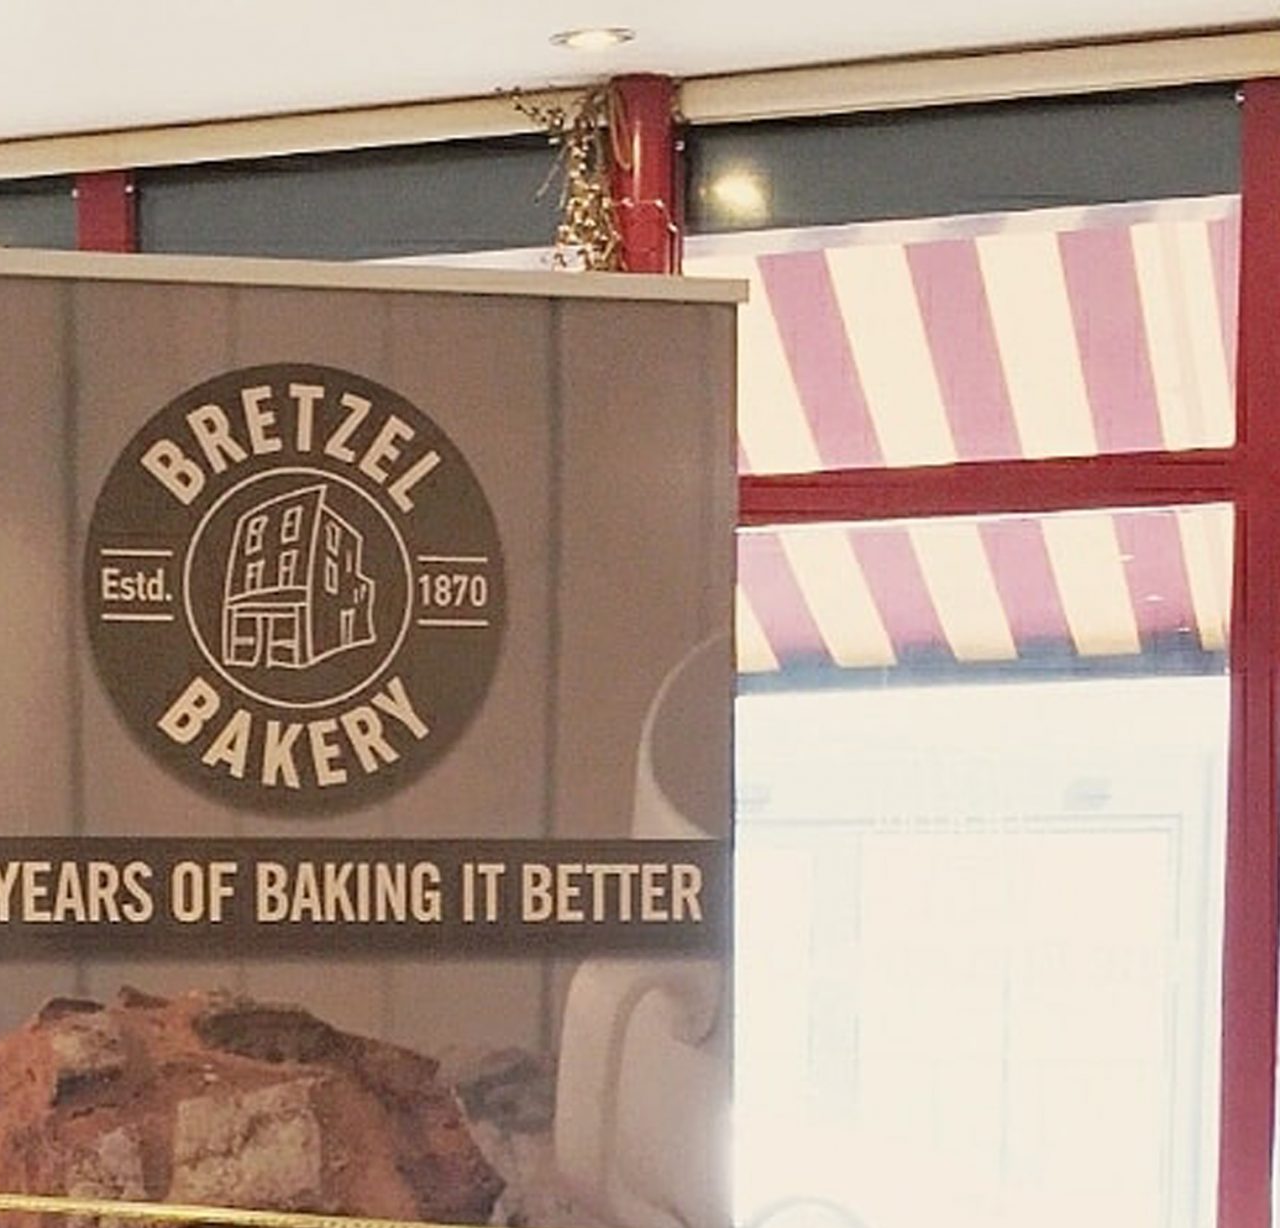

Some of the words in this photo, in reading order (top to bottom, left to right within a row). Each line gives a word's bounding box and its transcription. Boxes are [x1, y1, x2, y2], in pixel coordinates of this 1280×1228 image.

[140, 383, 441, 513] BRETZEL
[101, 568, 173, 602] Estd.
[419, 574, 488, 607] 1870
[157, 676, 430, 789] BAKERY
[172, 860, 238, 924] OF
[256, 861, 442, 923] BAKING
[462, 863, 506, 922] IT
[521, 863, 703, 923] BETTER
